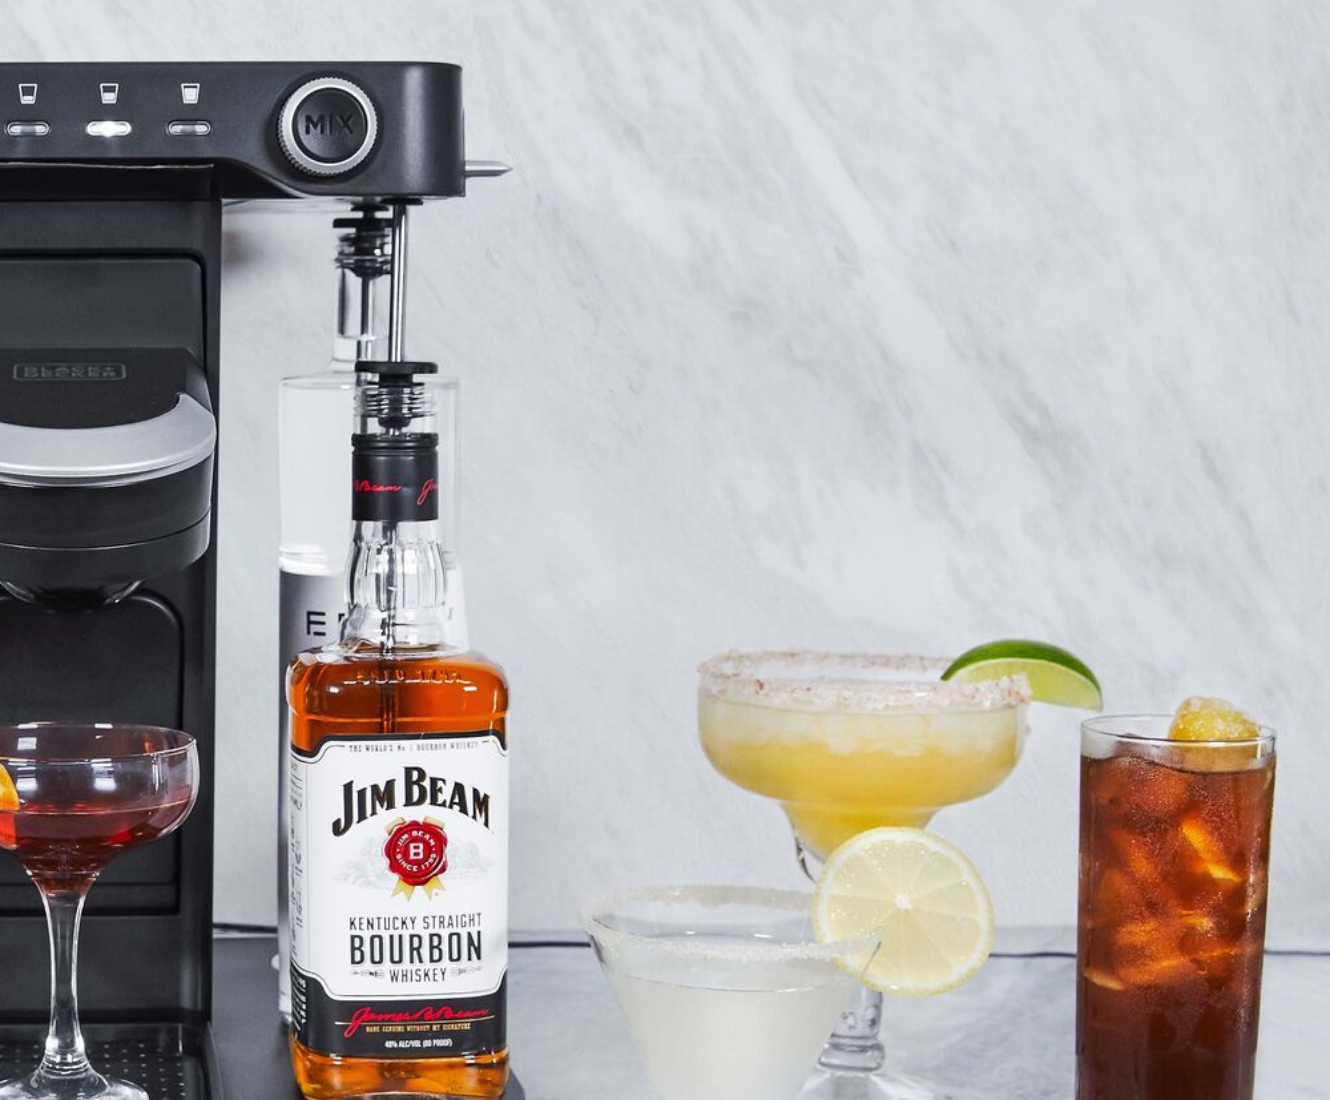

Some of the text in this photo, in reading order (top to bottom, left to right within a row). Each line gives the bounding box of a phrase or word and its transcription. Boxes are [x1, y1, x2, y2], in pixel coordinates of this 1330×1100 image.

[305, 114, 354, 135] MIX
[331, 778, 396, 837] JIM
[403, 766, 491, 829] BEAM
[411, 830, 436, 846] BEAM
[409, 842, 424, 860] B
[396, 853, 419, 872] SINCE
[349, 912, 483, 931] KENTUCKY STRAIGHT
[349, 931, 482, 965] BOURBON
[389, 967, 448, 984] WHISKEY
